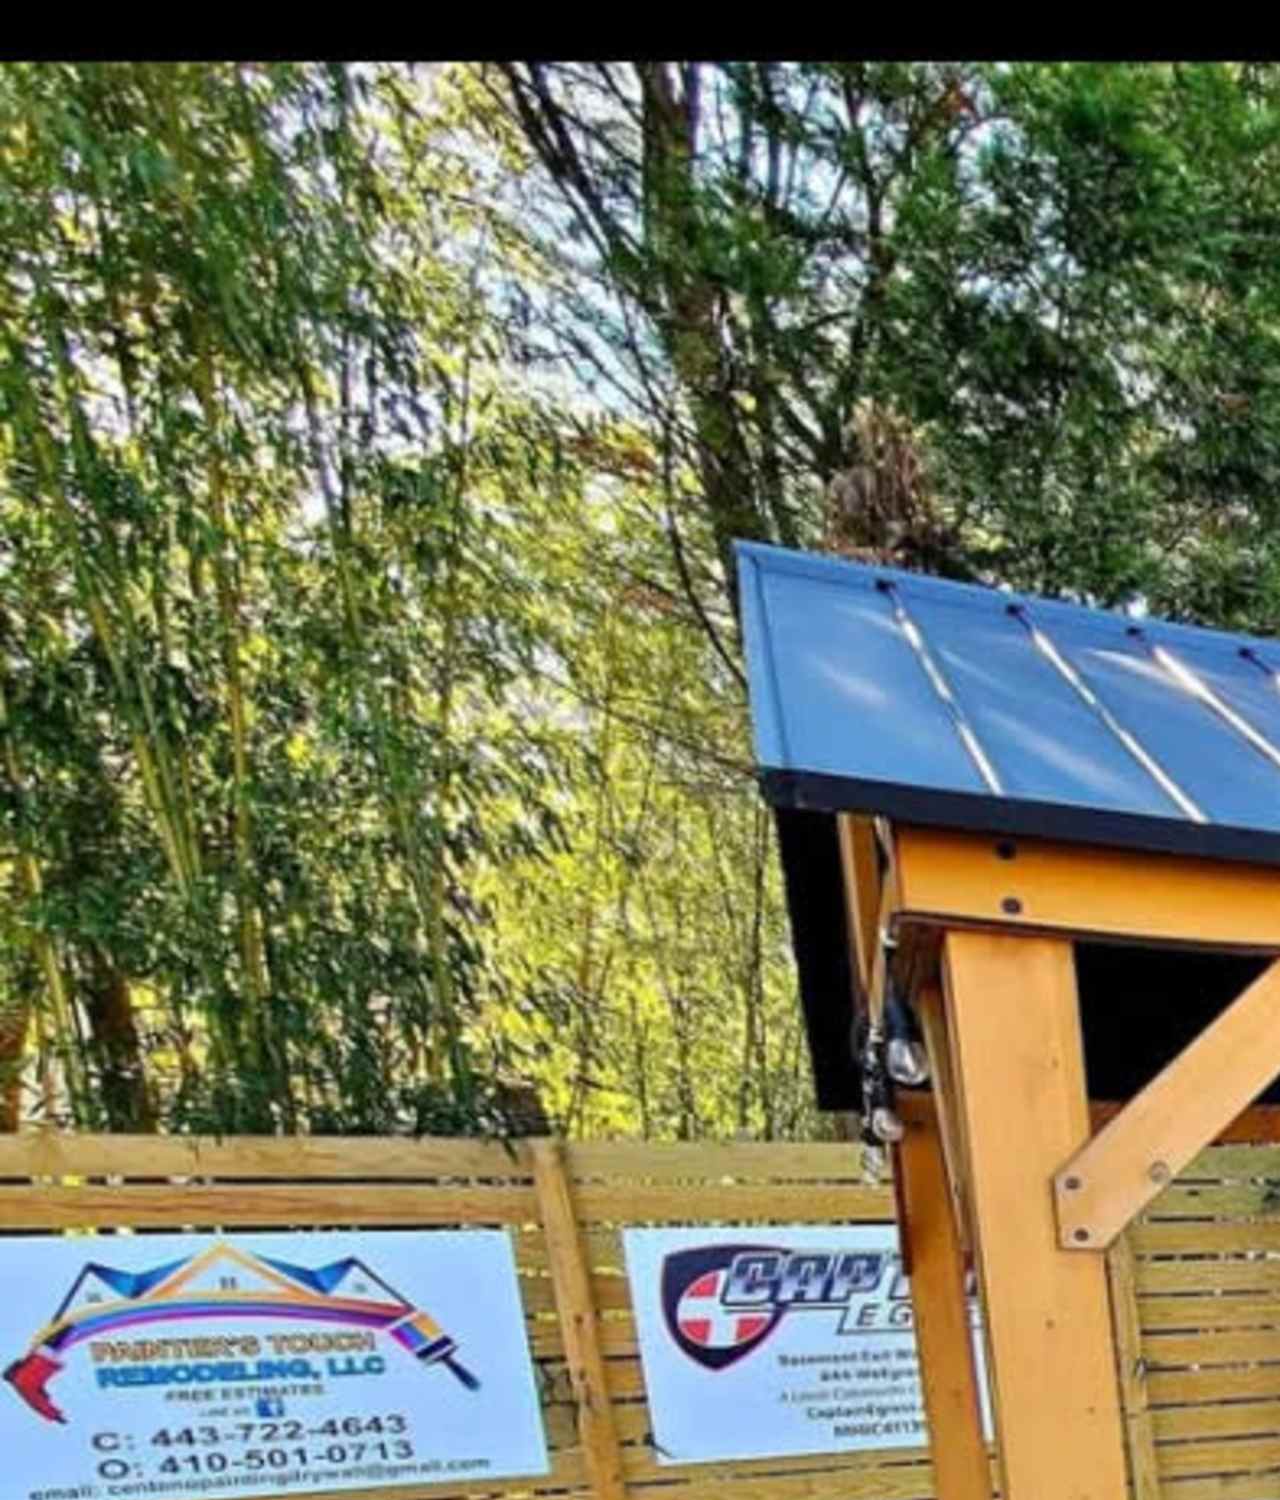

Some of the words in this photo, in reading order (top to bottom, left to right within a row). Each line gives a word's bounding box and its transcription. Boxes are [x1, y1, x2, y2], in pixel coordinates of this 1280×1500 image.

[91, 1335, 261, 1363] PAINTER'S
[265, 1332, 375, 1354] TOUCH
[96, 1361, 322, 1388] REMODELING,
[327, 1355, 386, 1377] LLC
[164, 1388, 215, 1402] FREE
[221, 1382, 325, 1399] ESTIMATES
[92, 1432, 135, 1452] C:
[151, 1413, 408, 1448] 443-722-4643
[97, 1458, 144, 1480] O:
[158, 1439, 415, 1474] 410-501-0713
